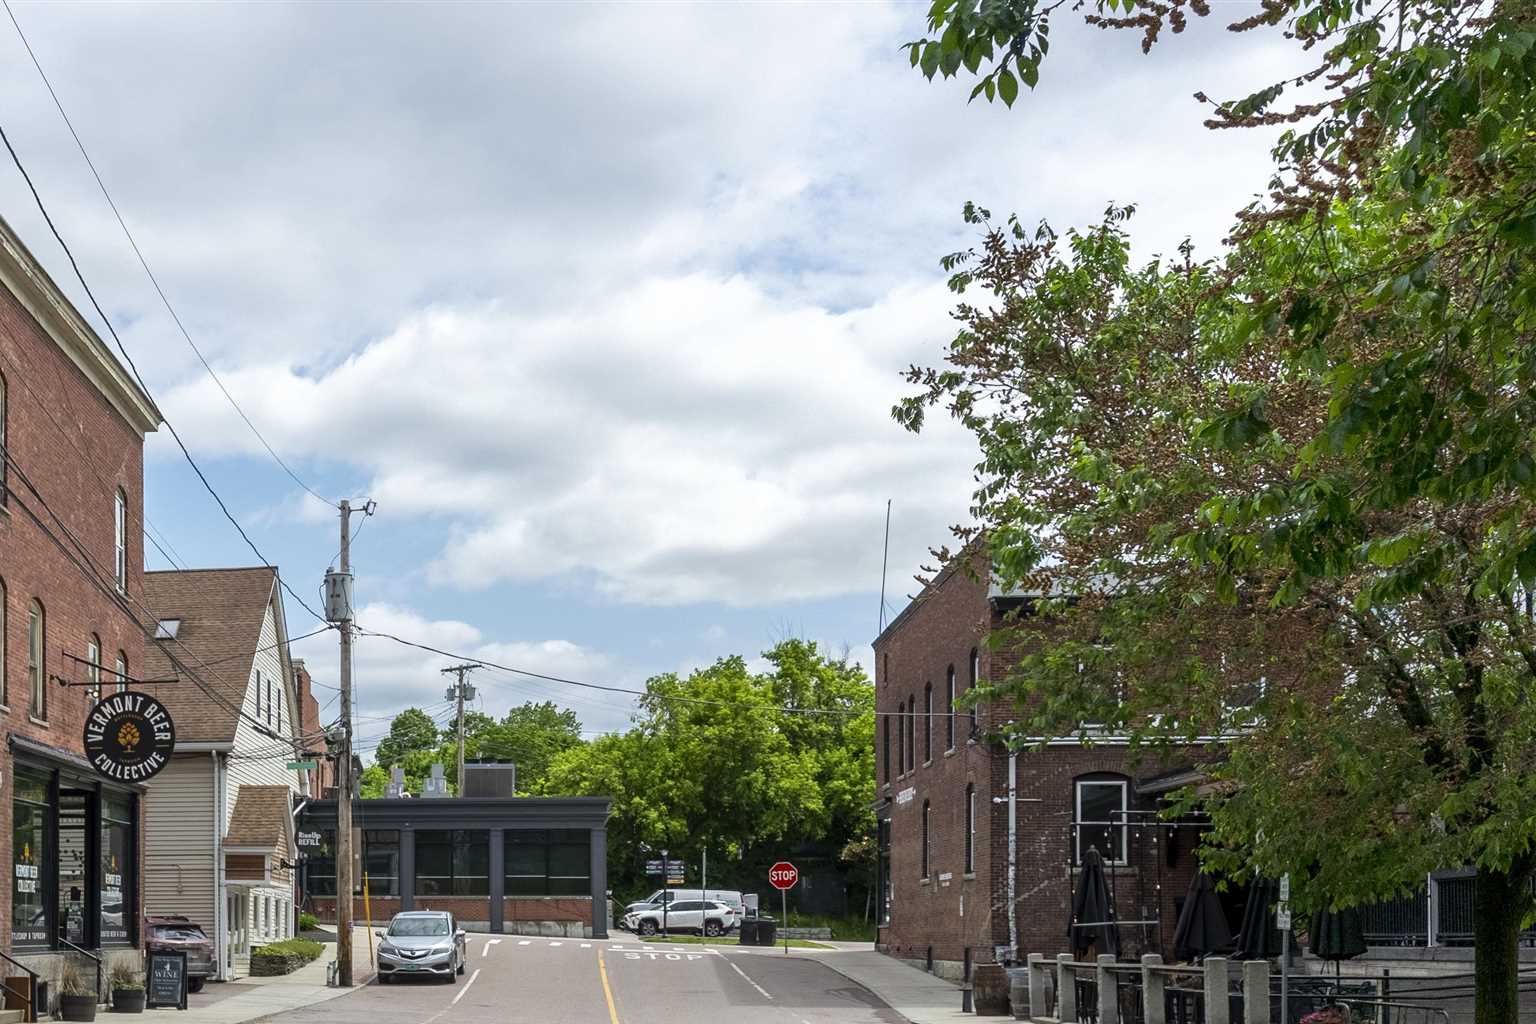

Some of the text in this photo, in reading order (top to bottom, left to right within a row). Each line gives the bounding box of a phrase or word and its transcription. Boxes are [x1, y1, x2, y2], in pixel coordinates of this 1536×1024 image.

[87, 695, 171, 742] VERMONT BEER
[95, 751, 165, 779] COLLECTIVE
[771, 870, 796, 881] STOP
[624, 952, 703, 960] STOP
